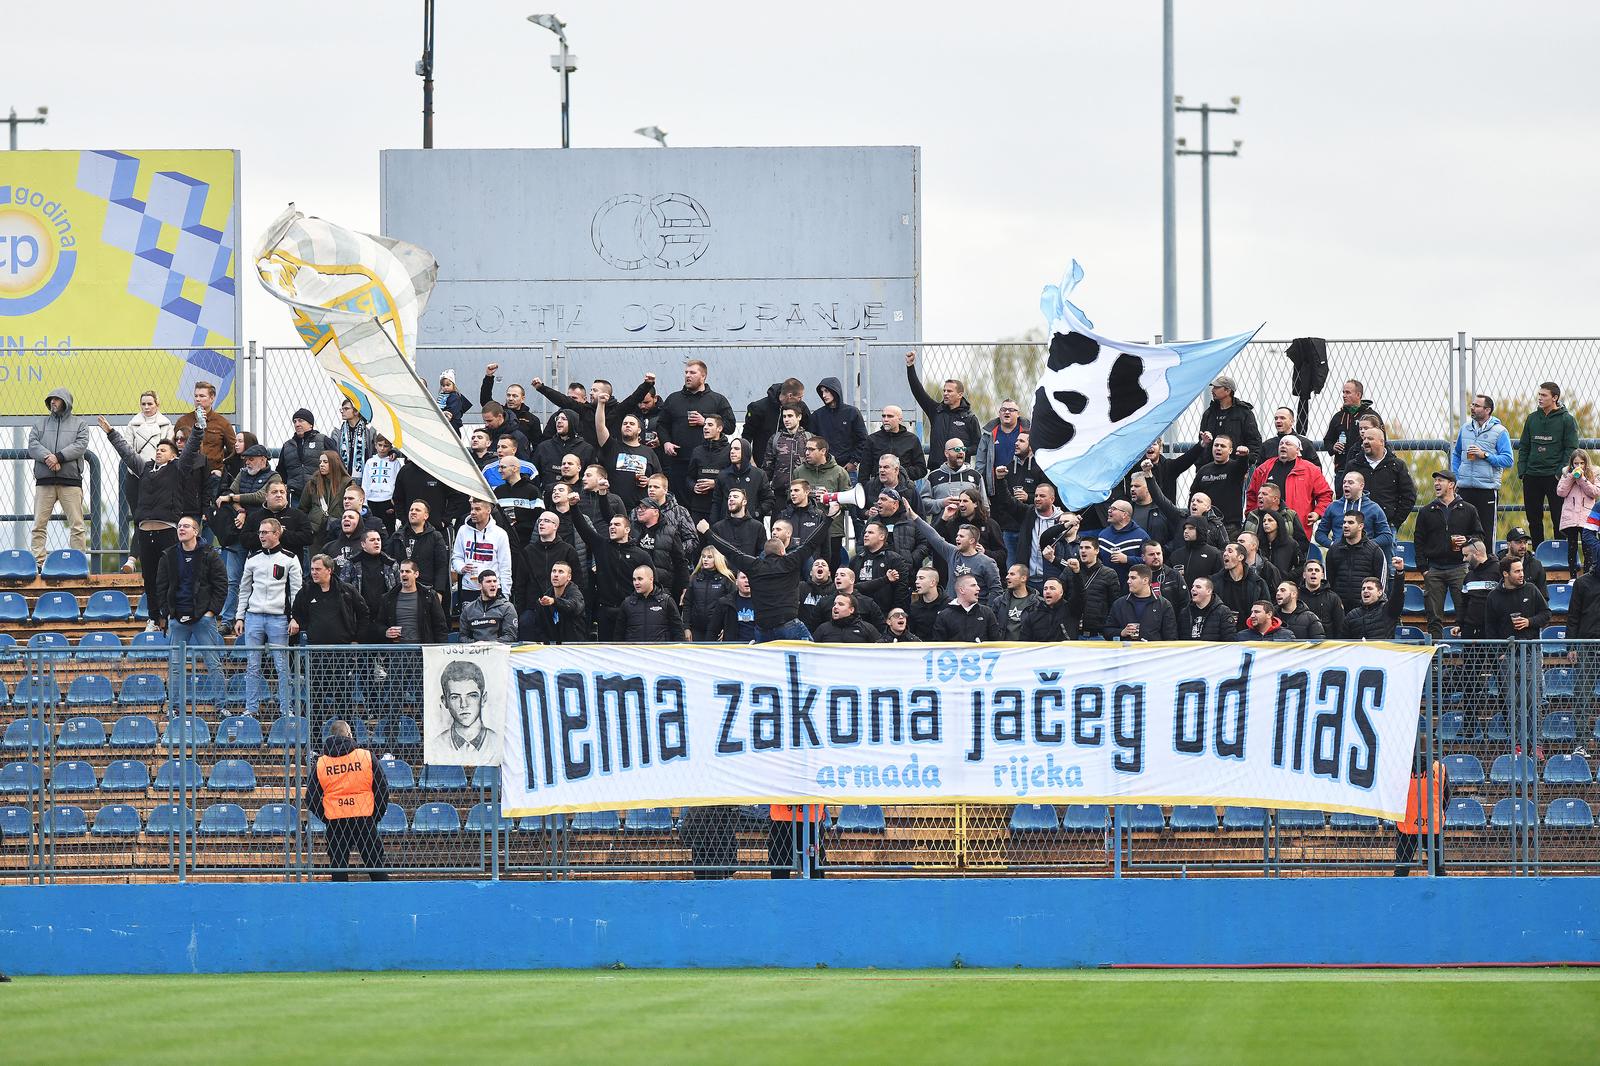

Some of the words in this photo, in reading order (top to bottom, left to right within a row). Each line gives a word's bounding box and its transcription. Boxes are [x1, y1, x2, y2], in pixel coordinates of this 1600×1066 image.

[15, 187, 76, 247] godina
[621, 302, 888, 332] OSIGURANJE
[922, 650, 1002, 682] 1987
[513, 667, 691, 793] nema
[714, 651, 944, 757] zakona
[964, 669, 1147, 776] jačeg
[1172, 649, 1256, 762] od
[1271, 665, 1387, 792] nas
[326, 761, 362, 776] REDAR
[815, 753, 943, 789] armada
[993, 753, 1084, 796] rijeka
[338, 798, 355, 807] 948
